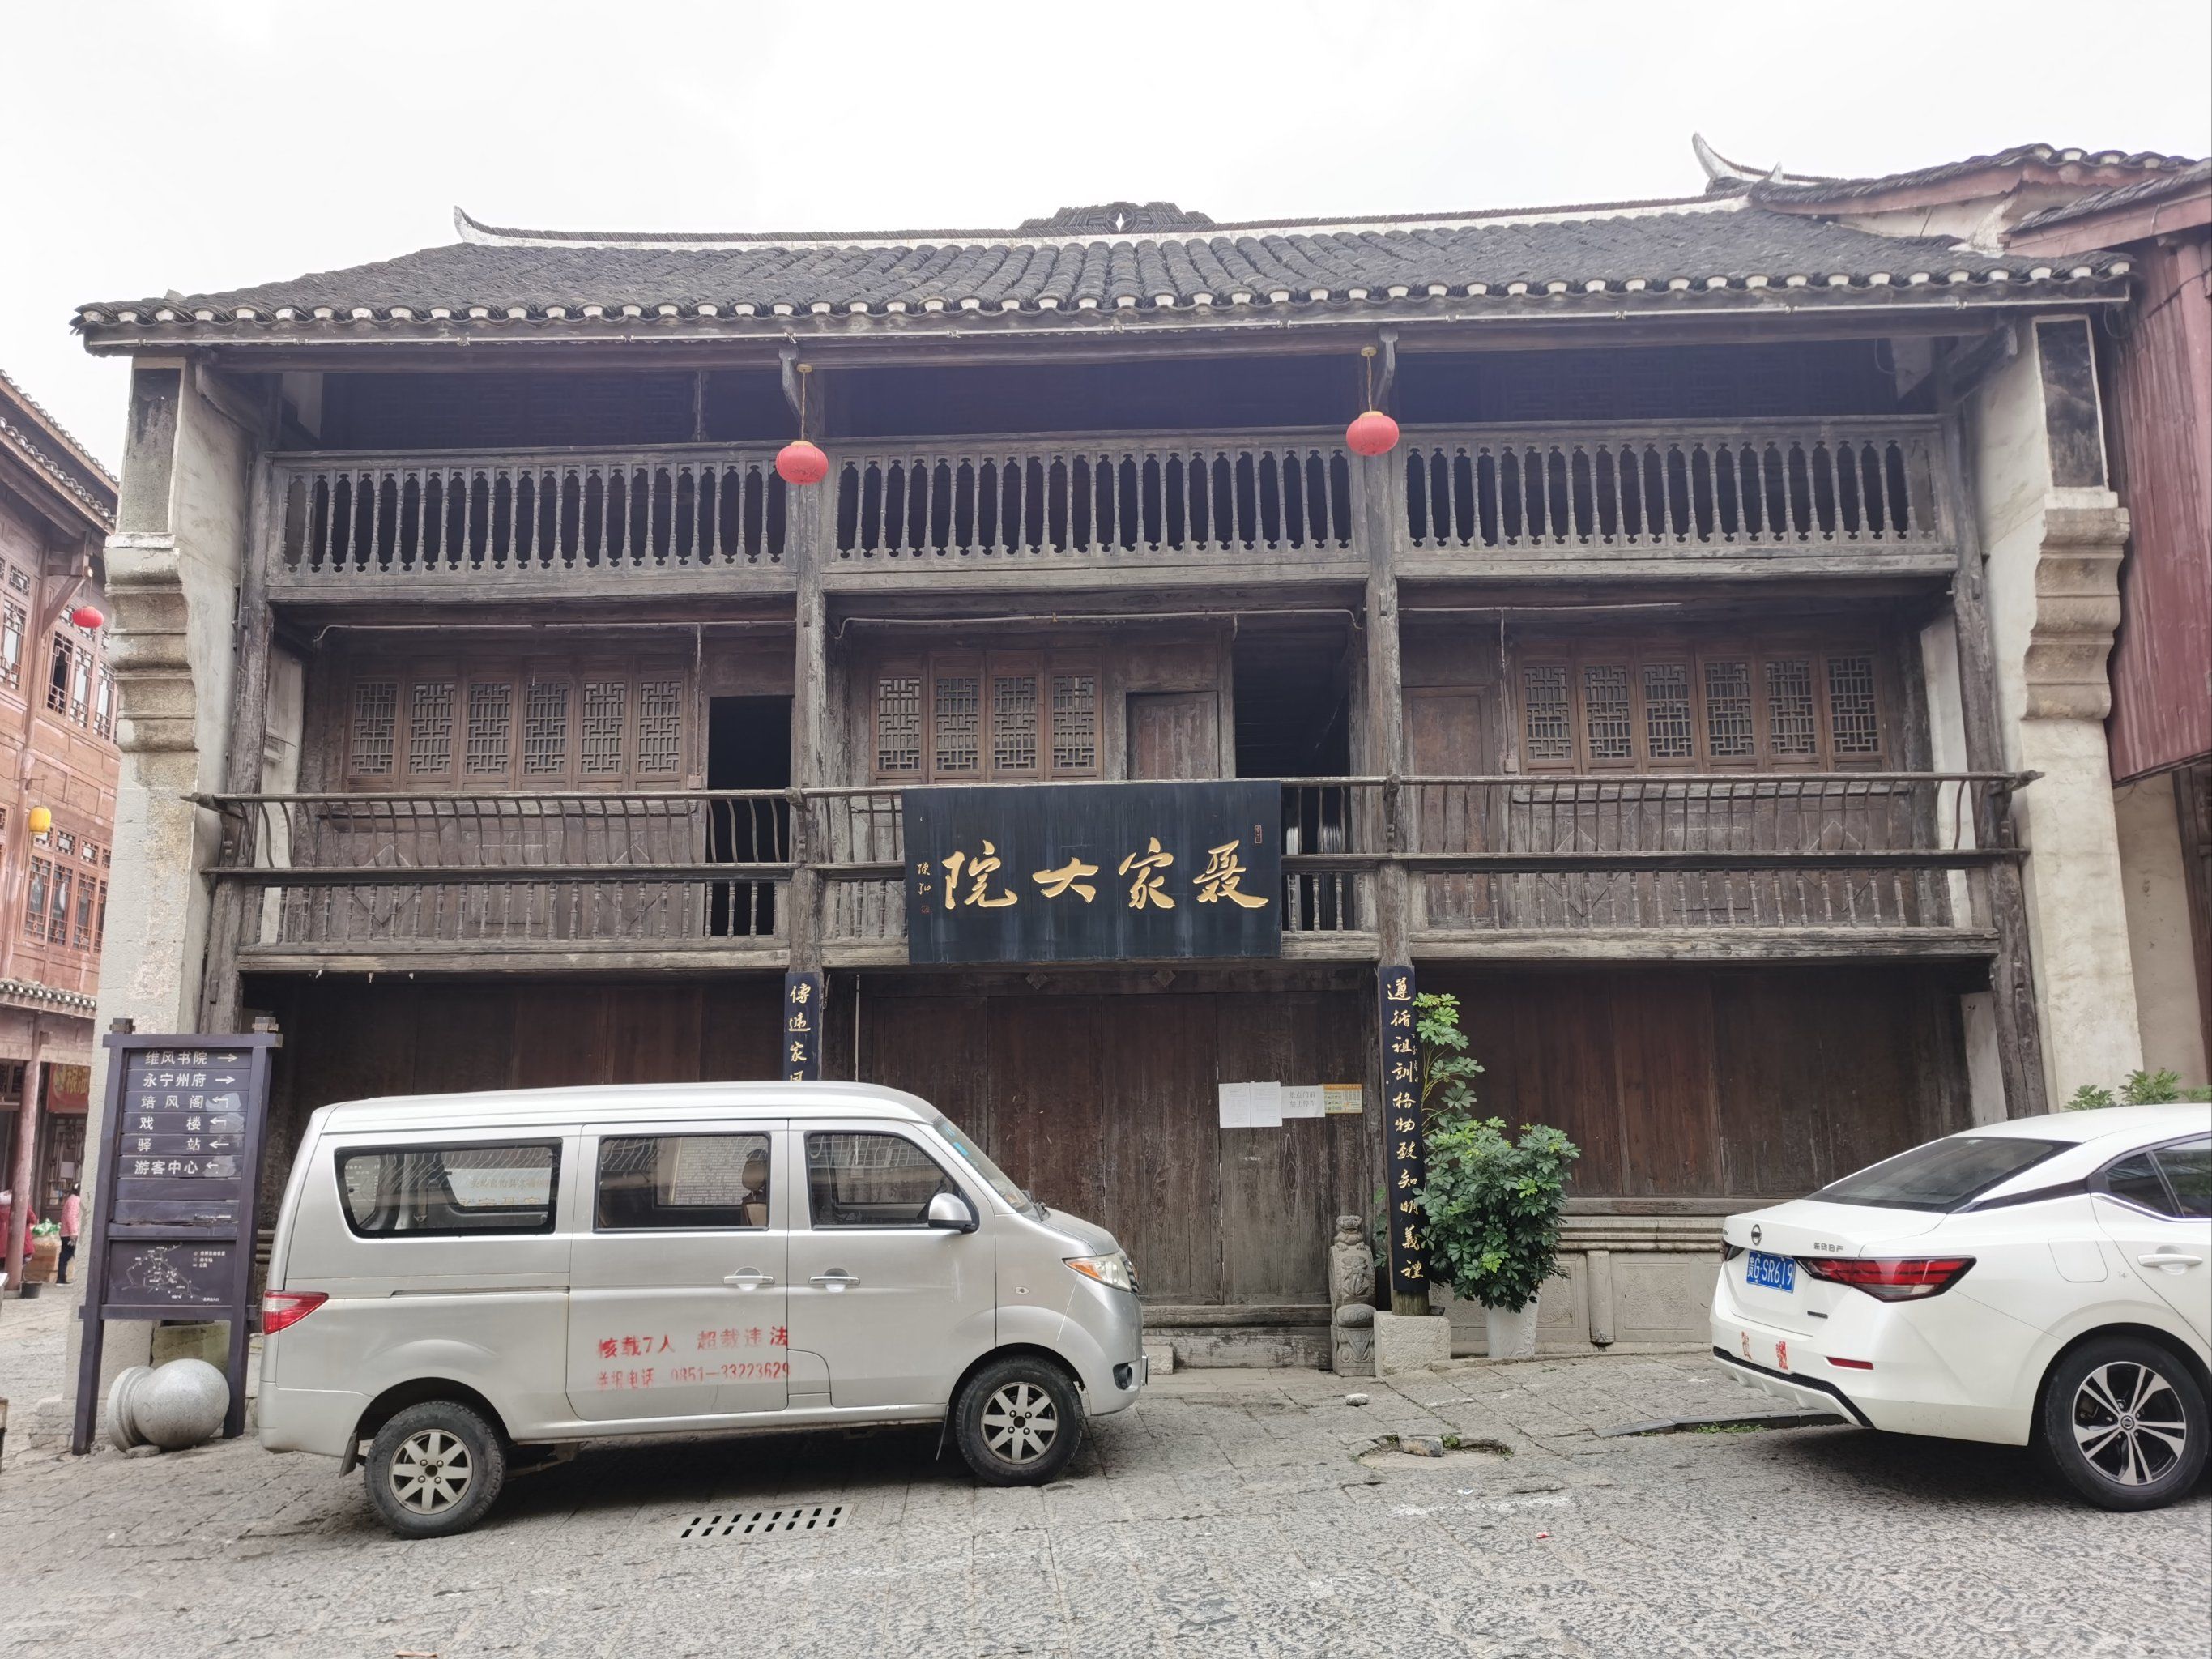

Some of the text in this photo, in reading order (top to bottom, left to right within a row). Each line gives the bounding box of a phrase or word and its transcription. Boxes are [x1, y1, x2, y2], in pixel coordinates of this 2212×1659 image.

[145, 1051, 207, 1066] 维风书院
[143, 1073, 206, 1088] 永宁州府
[141, 1095, 203, 1109] 培风阁
[139, 1116, 202, 1131] 戏楼
[137, 1137, 201, 1152] 驿站
[134, 1160, 198, 1175] 游客中心
[597, 1326, 788, 1358] 核载7人 超载违法
[597, 1368, 655, 1391] 举报电话
